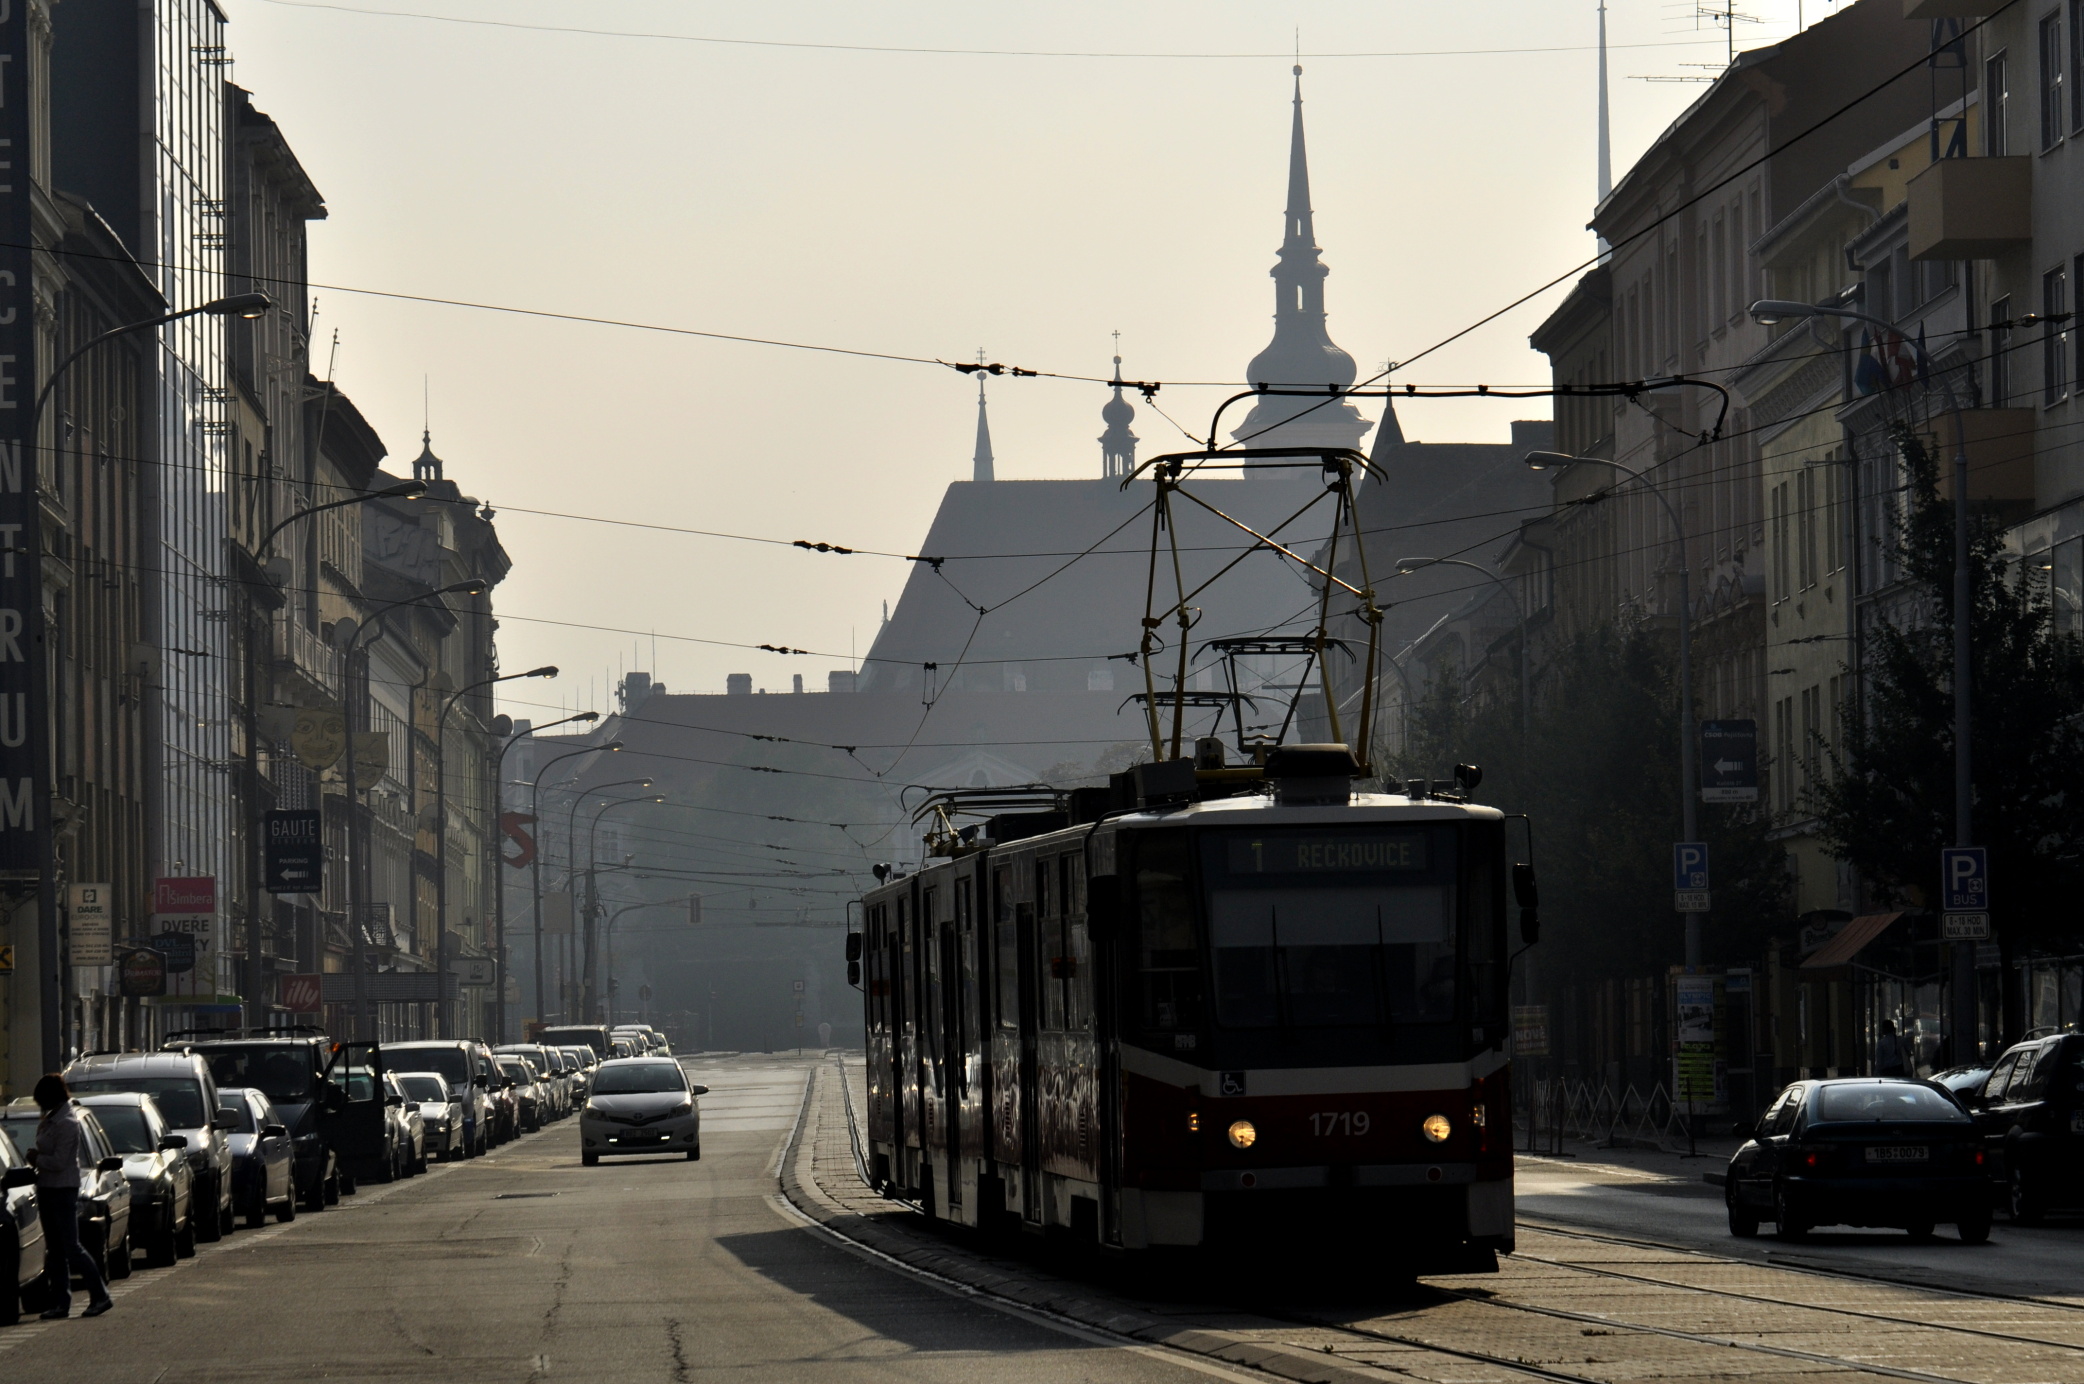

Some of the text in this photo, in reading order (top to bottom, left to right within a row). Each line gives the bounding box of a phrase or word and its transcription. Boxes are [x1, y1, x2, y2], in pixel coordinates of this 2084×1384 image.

[271, 819, 316, 837] GAUTE
[1251, 839, 1411, 872] 1 ŘEČKOVICE
[1681, 848, 1701, 876] P
[1951, 855, 1977, 891] P
[170, 890, 213, 905] Šimbera
[1953, 894, 1978, 905] BUS
[77, 906, 103, 914] DARE
[161, 915, 209, 933] DVEŘE
[1949, 916, 1953, 925] 8
[1958, 916, 1966, 925] 18
[1964, 926, 1971, 935] 30
[286, 980, 319, 1009] illy
[1308, 1111, 1370, 1136] 1719
